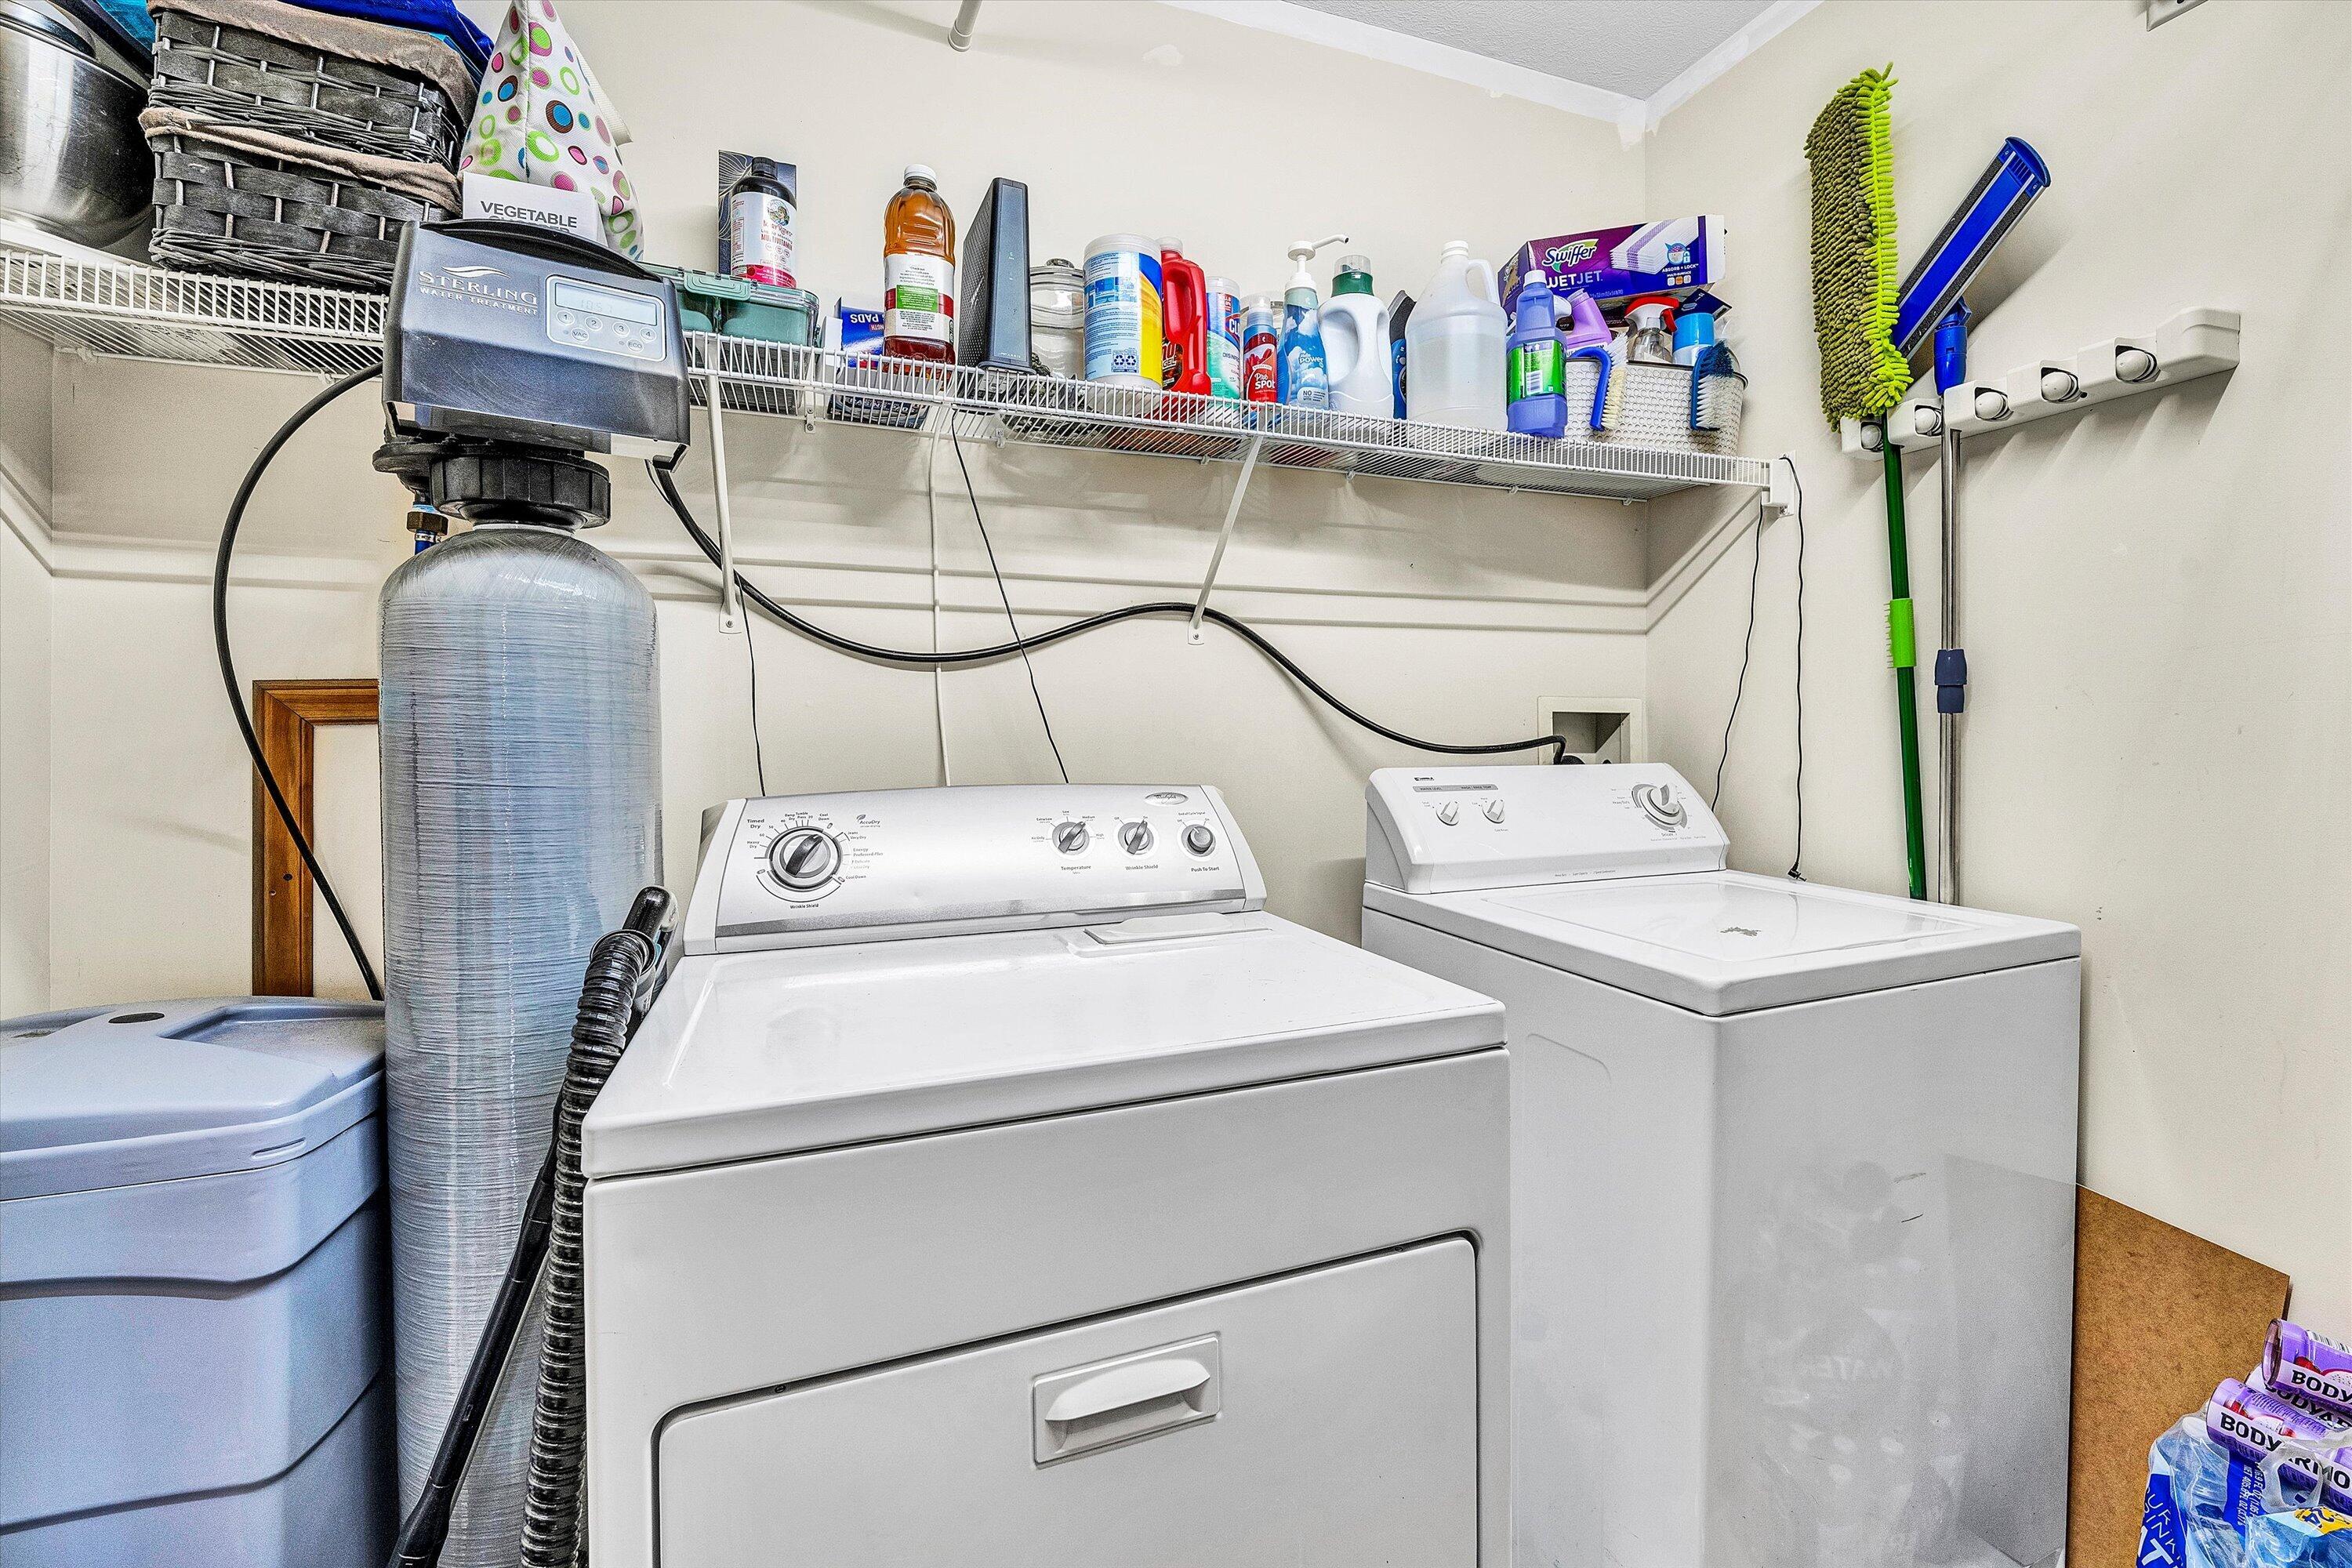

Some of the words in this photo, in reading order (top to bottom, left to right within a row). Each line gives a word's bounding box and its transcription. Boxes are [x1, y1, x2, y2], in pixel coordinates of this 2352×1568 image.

[480, 201, 577, 228] VEGETABLE
[1543, 245, 1595, 267] Swiffer
[419, 270, 538, 306] STERLING
[419, 287, 463, 301] WATER
[470, 296, 538, 315] TREATMENT
[850, 314, 879, 324] PADS
[1229, 318, 1240, 334] CL
[1163, 358, 1177, 368] GEL
[1254, 372, 1269, 383] Pre
[2291, 1370, 2352, 1403] BODY
[2243, 1464, 2252, 1477] NET
[2301, 1507, 2336, 1530] 24
